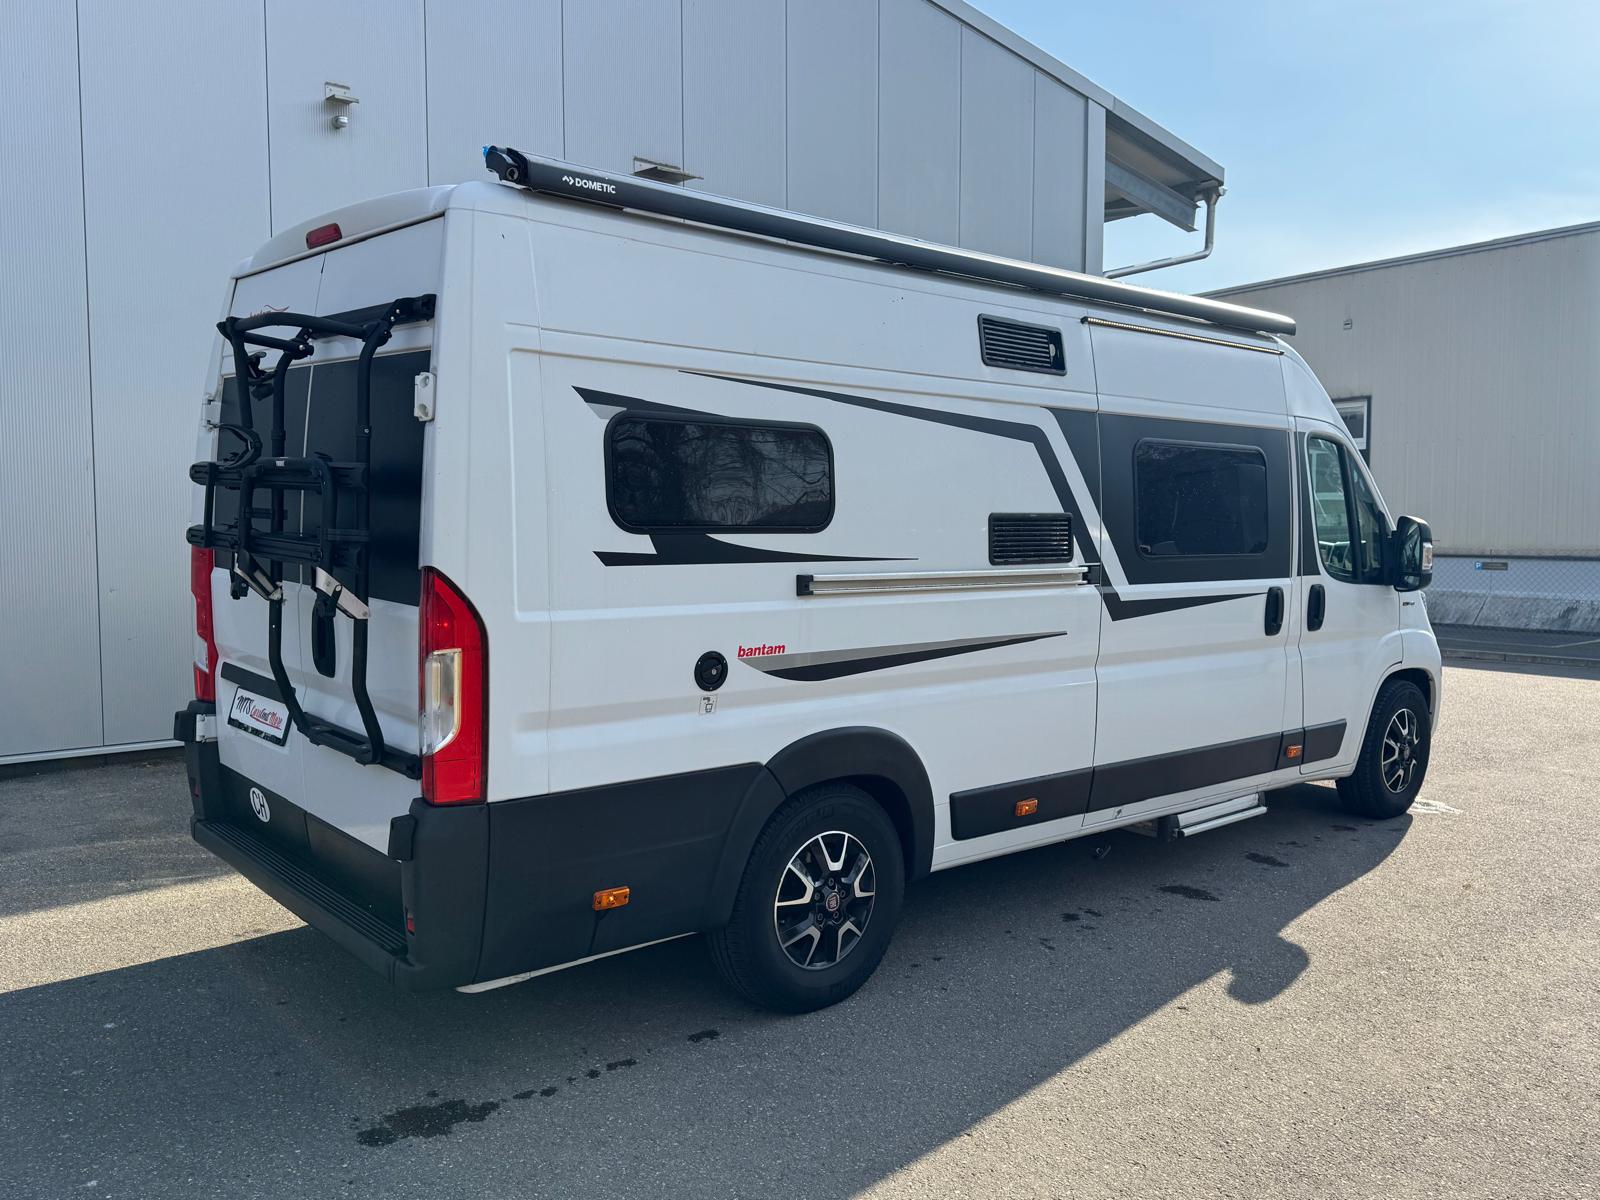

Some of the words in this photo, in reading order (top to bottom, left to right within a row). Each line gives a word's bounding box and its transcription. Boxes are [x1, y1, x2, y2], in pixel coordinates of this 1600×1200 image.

[575, 177, 616, 194] DOMETIC
[737, 643, 785, 658] bantam
[252, 790, 268, 820] CH
